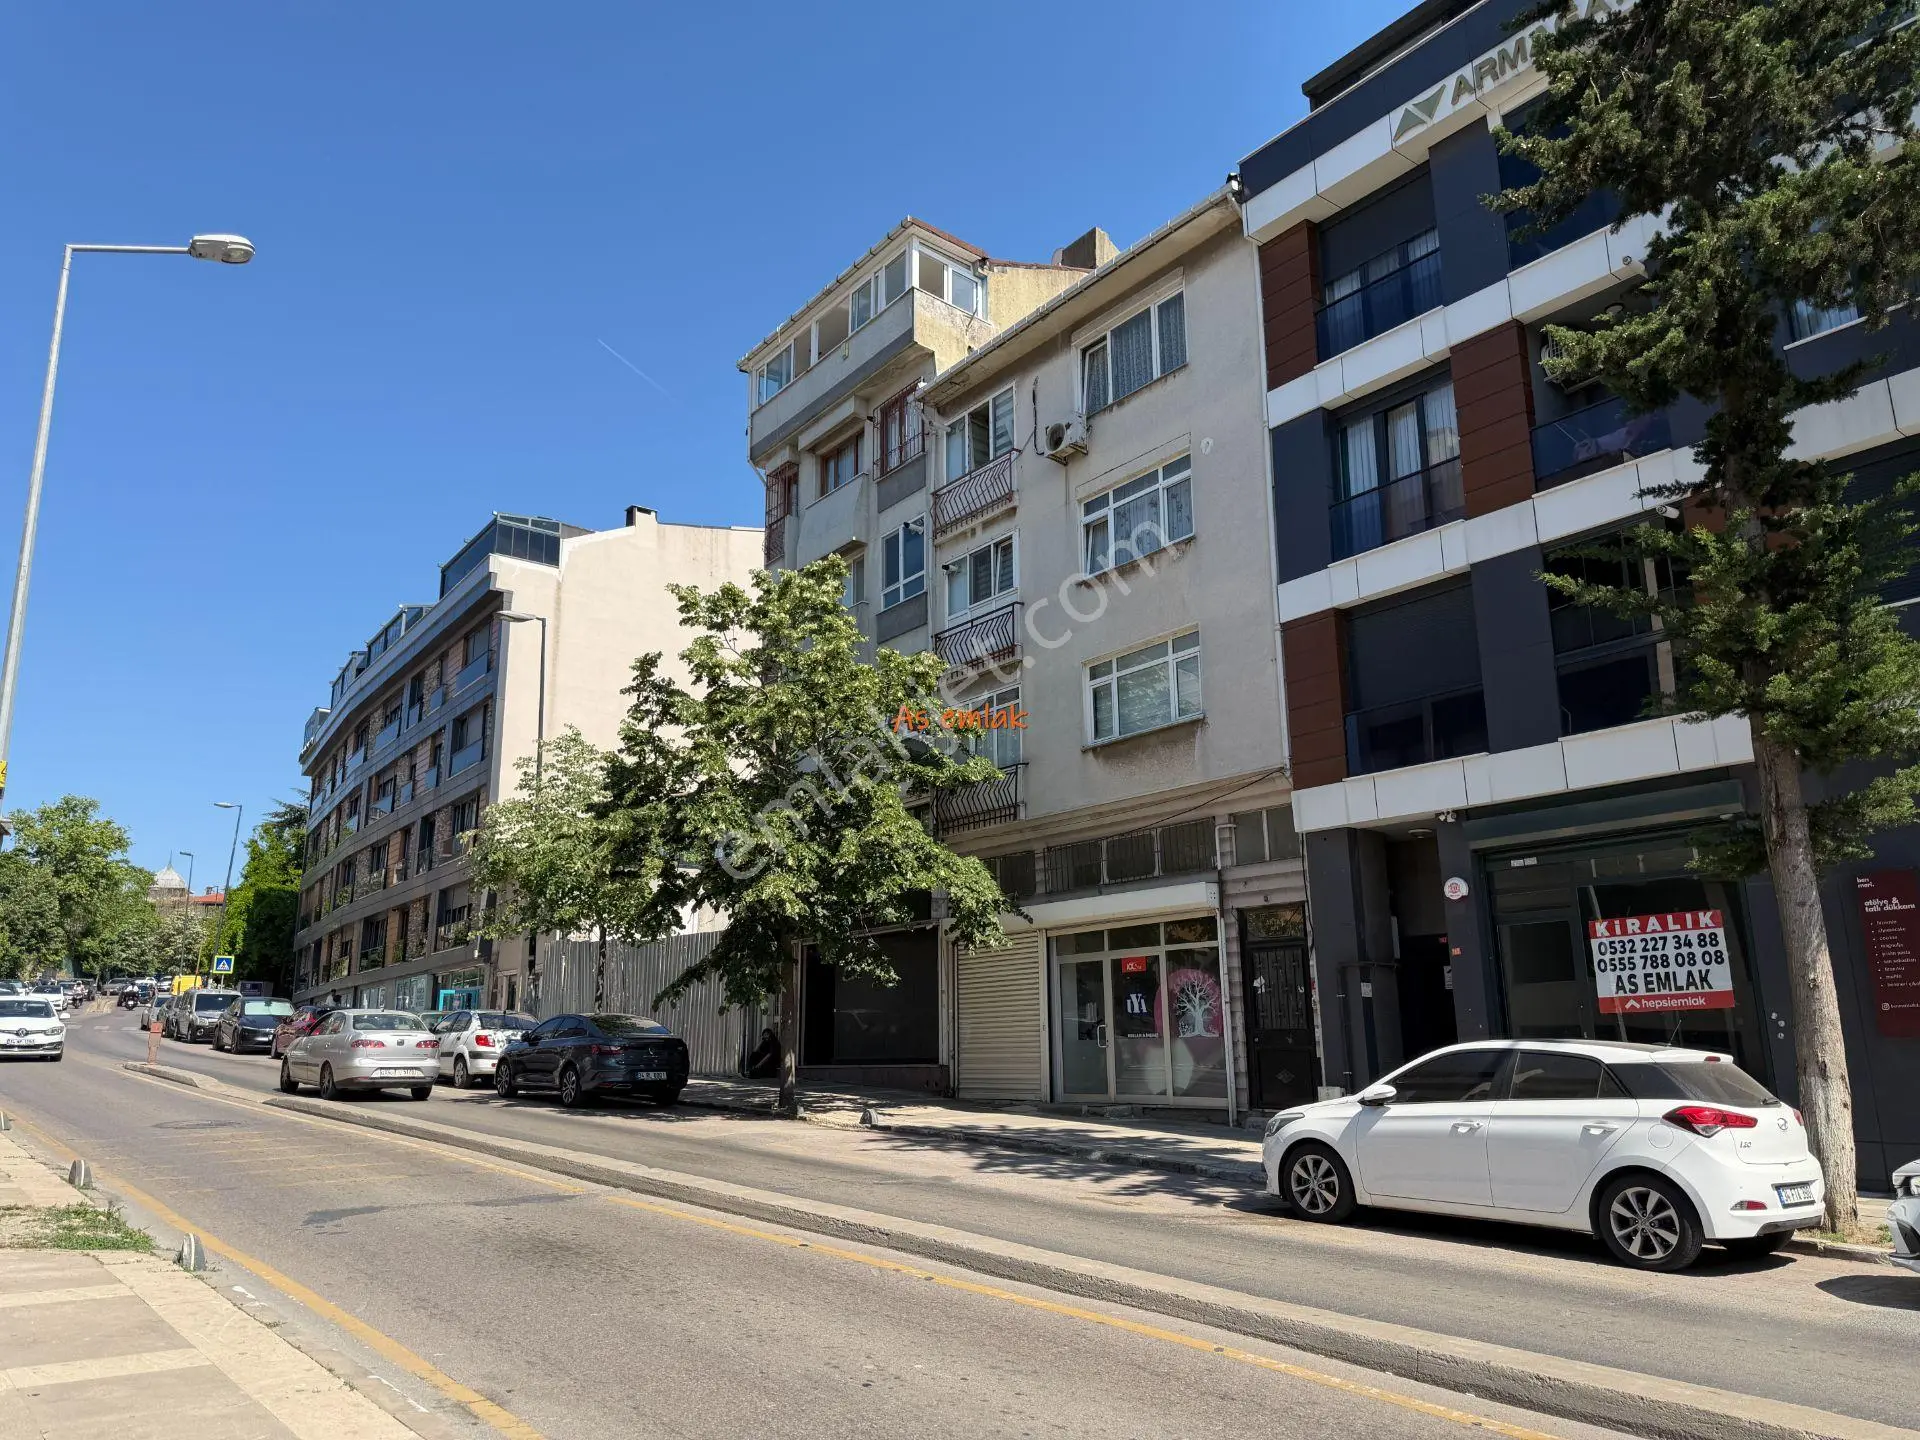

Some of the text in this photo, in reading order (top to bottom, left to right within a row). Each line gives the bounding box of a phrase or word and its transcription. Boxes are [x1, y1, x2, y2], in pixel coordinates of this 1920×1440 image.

[1597, 932, 1720, 956] 0532 227 34 88
[1597, 950, 1725, 973] 0555 788 08 08
[1615, 969, 1714, 995] AS EMLAK
[1641, 996, 1706, 1009] hepsiemlak
